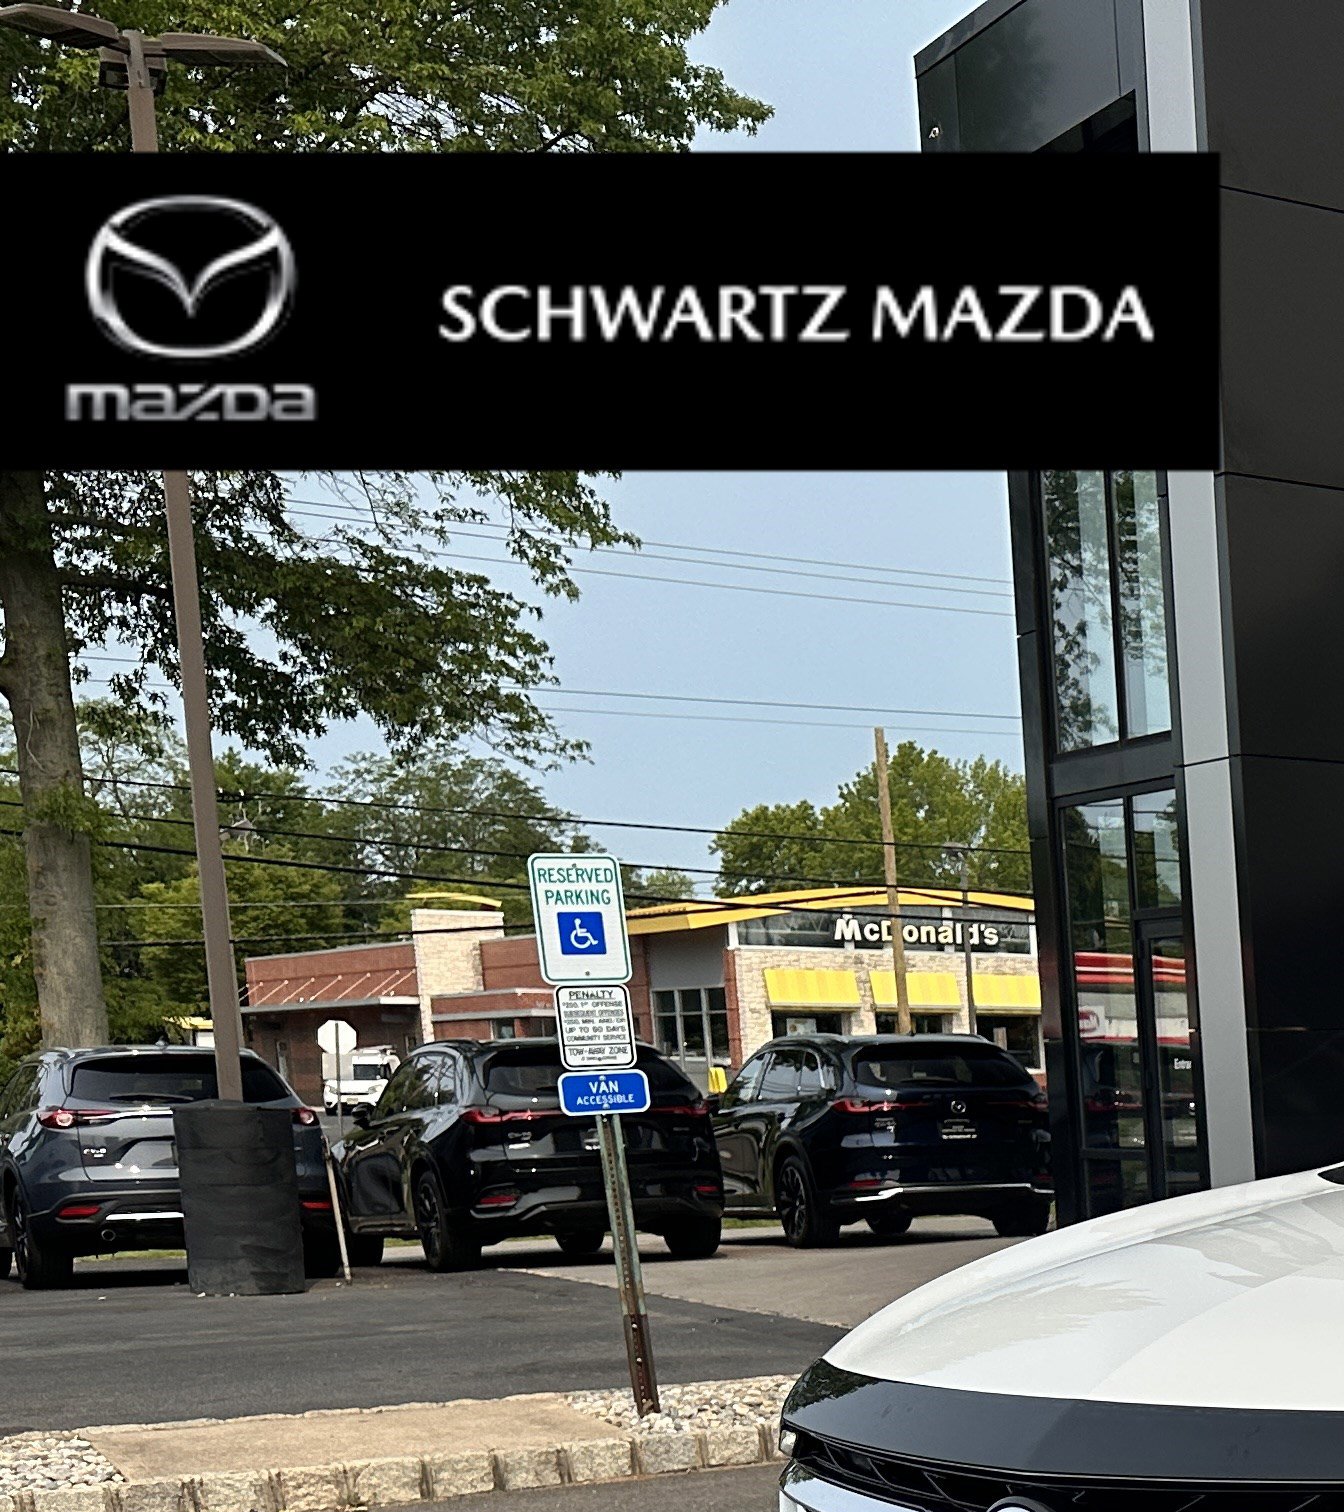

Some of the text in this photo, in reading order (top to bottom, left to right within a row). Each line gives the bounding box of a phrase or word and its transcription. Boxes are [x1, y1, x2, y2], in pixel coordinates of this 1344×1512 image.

[537, 867, 614, 884] RESERVED
[545, 888, 612, 905] PARKING
[834, 917, 999, 946] McDonald's
[568, 990, 614, 1000] PENALTY
[608, 1046, 629, 1055] ZONE
[588, 1080, 619, 1094] VAN
[576, 1093, 635, 1106] ACCESSIBLE
